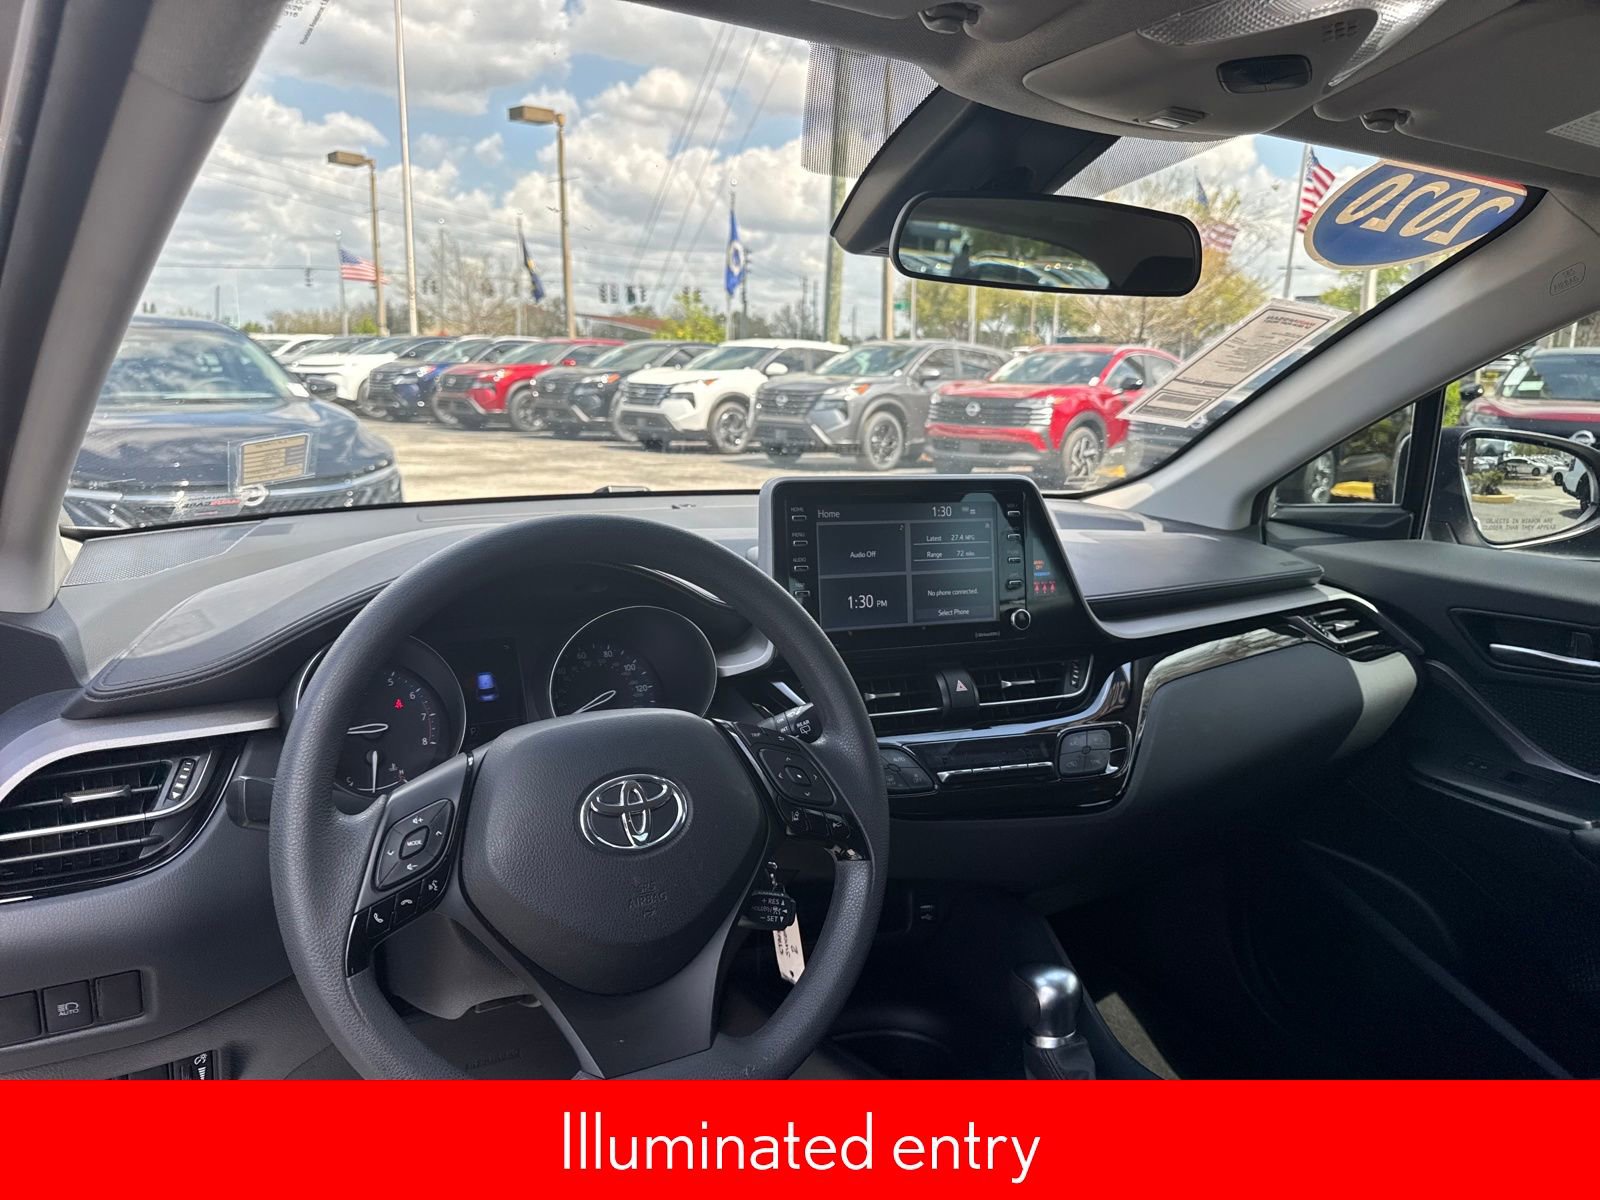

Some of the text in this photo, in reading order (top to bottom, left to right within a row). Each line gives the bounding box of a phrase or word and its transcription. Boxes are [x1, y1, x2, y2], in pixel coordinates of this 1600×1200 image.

[817, 509, 841, 519] Home
[931, 506, 952, 517] 1:30
[926, 551, 943, 559] Range
[936, 589, 951, 598] phone
[847, 594, 888, 609] 1:30 PM
[954, 608, 970, 616] Phone
[603, 650, 613, 658] 80
[624, 663, 636, 672] 100
[387, 678, 394, 687] 5
[636, 684, 648, 693] 120
[409, 692, 416, 700] 6
[421, 713, 427, 721] 7
[796, 719, 811, 728] REAR
[422, 738, 428, 746] 8
